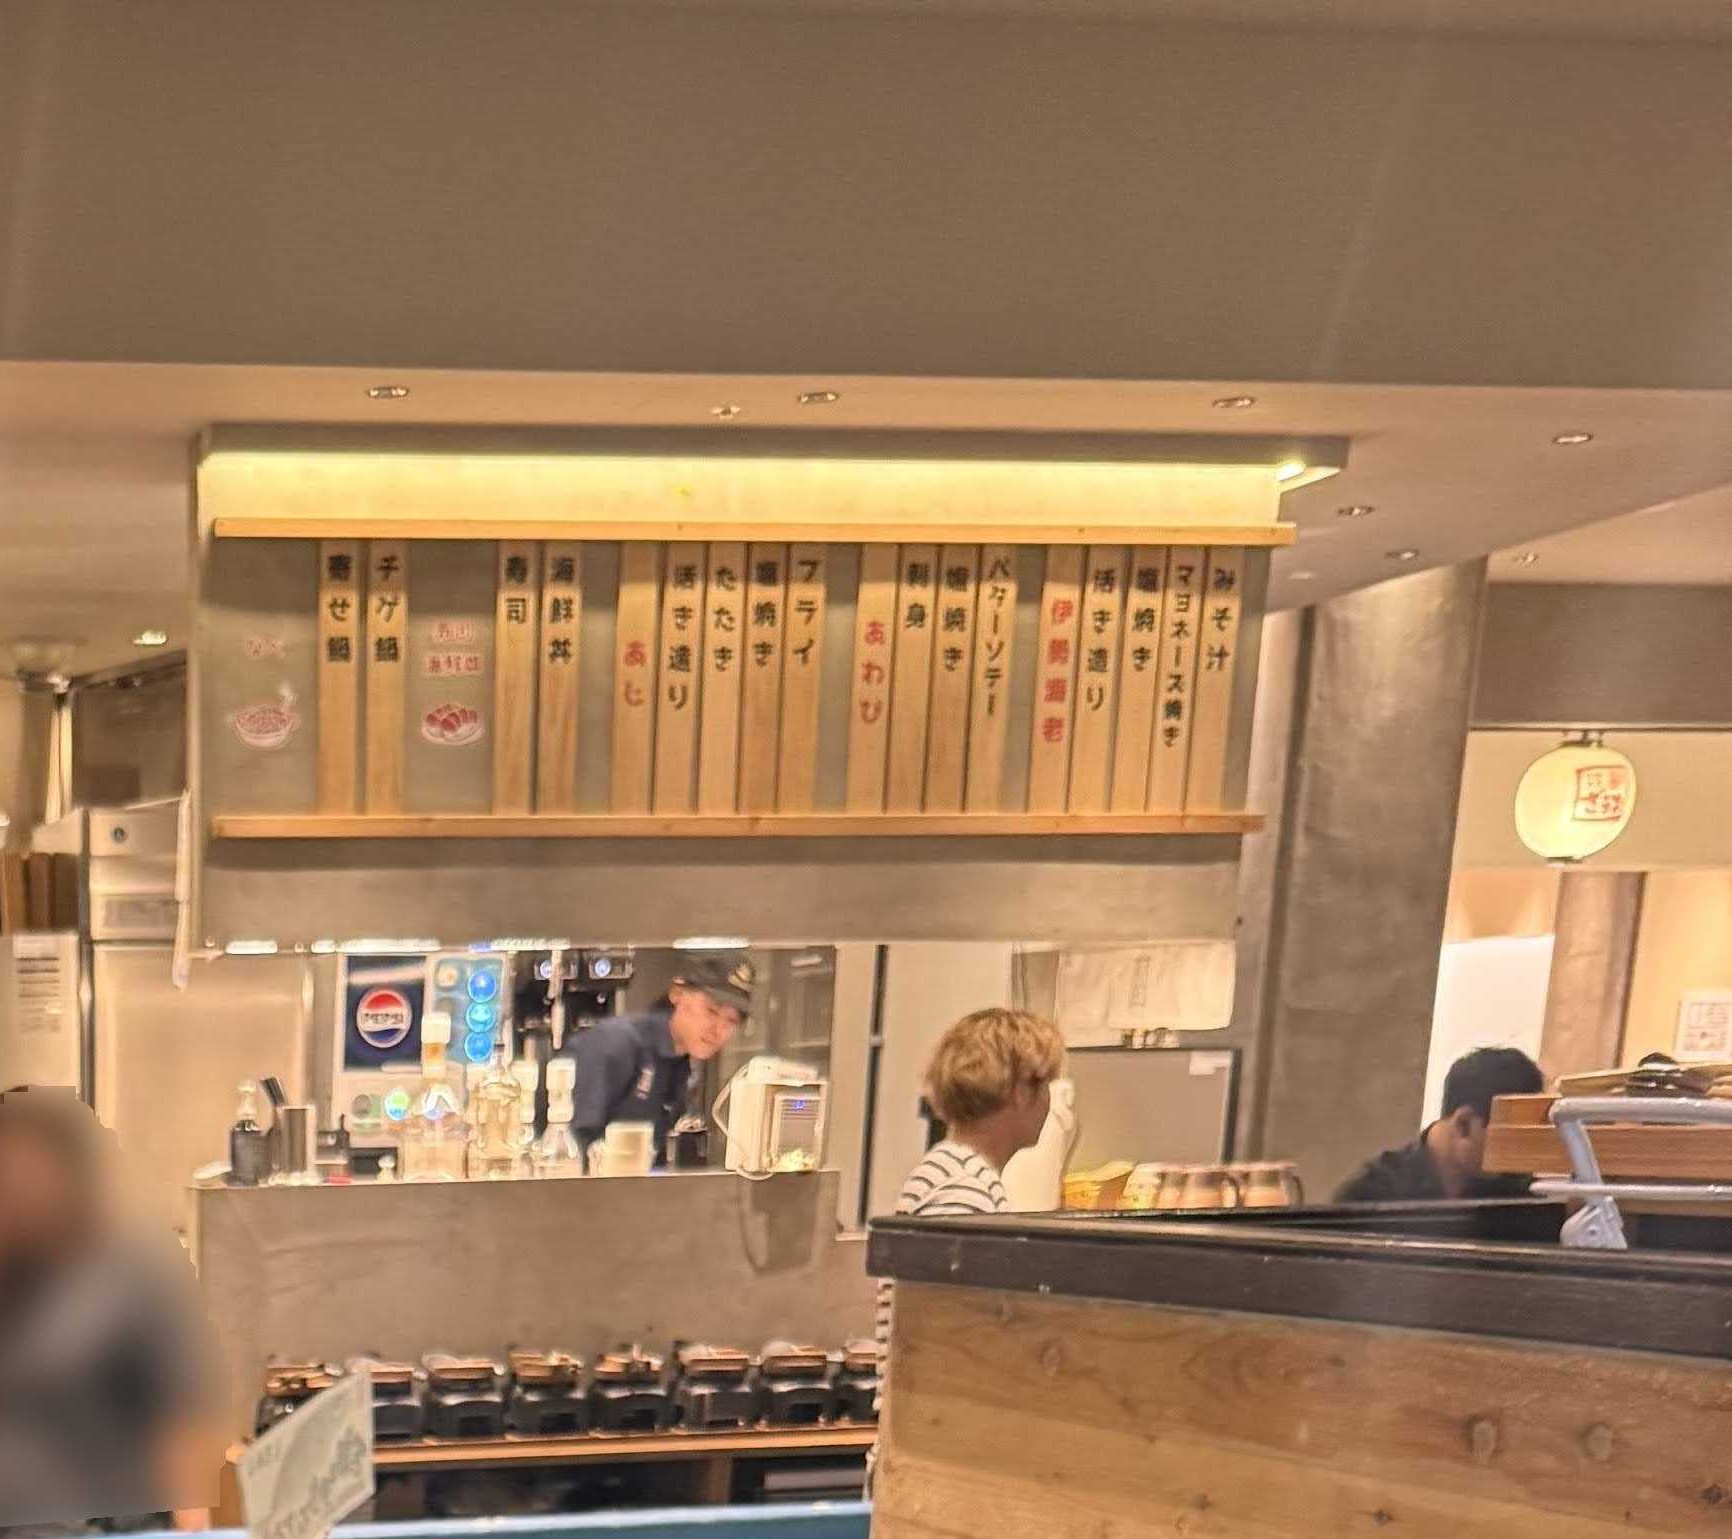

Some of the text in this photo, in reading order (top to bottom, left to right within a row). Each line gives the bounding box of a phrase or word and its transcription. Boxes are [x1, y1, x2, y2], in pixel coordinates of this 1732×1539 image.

[668, 564, 698, 711] 活き造り
[714, 565, 737, 672] たたき
[793, 560, 820, 665] フライ
[1086, 568, 1116, 712] 活き造り
[1206, 568, 1236, 672] みそ汁
[623, 640, 647, 707] あじ
[859, 621, 885, 726] あわび
